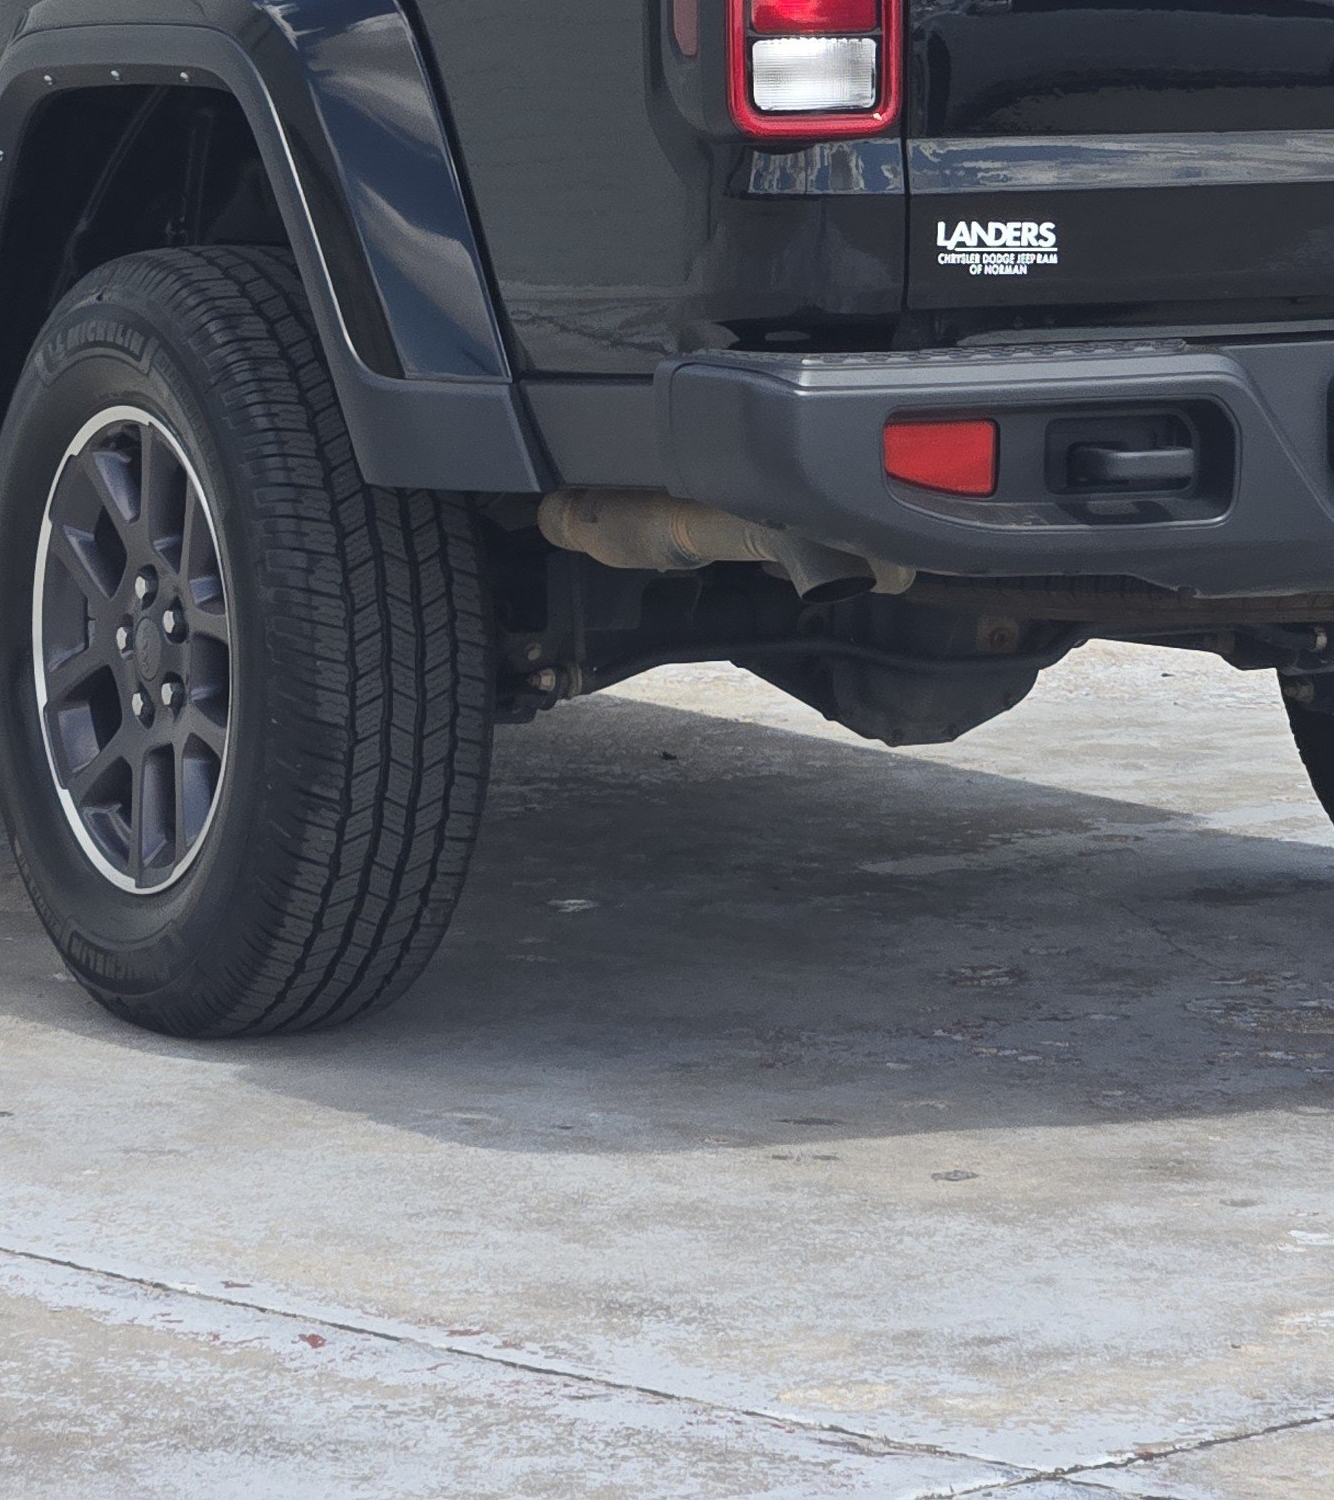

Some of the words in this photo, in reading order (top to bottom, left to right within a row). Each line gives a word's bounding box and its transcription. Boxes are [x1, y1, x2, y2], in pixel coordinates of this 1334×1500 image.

[936, 220, 1057, 250] LANDERS
[937, 253, 981, 264] CHRYSLER
[982, 253, 1015, 264] DODGE
[1016, 253, 1036, 264] JEEP
[1036, 253, 1058, 264] RAM
[969, 264, 982, 275] OF
[984, 264, 1028, 275] NORMAN
